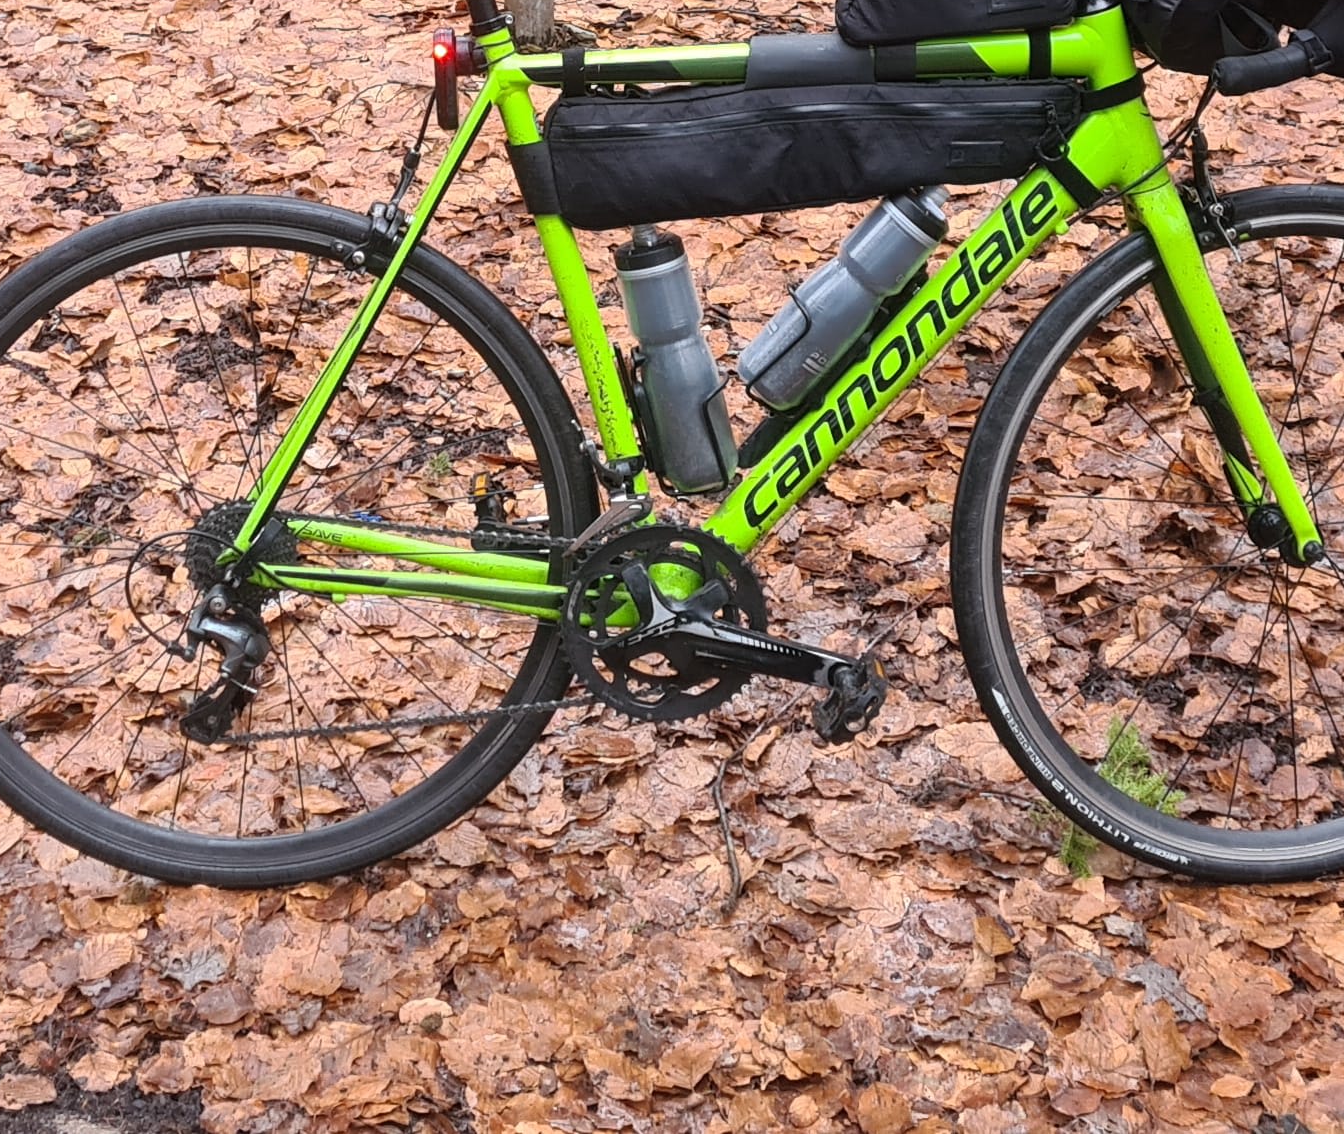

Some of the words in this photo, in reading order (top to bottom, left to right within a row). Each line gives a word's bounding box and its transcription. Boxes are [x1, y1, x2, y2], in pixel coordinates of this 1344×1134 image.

[744, 181, 1058, 529] cannondale
[302, 526, 344, 543] SAVE
[1051, 779, 1131, 844] LITHION.2
